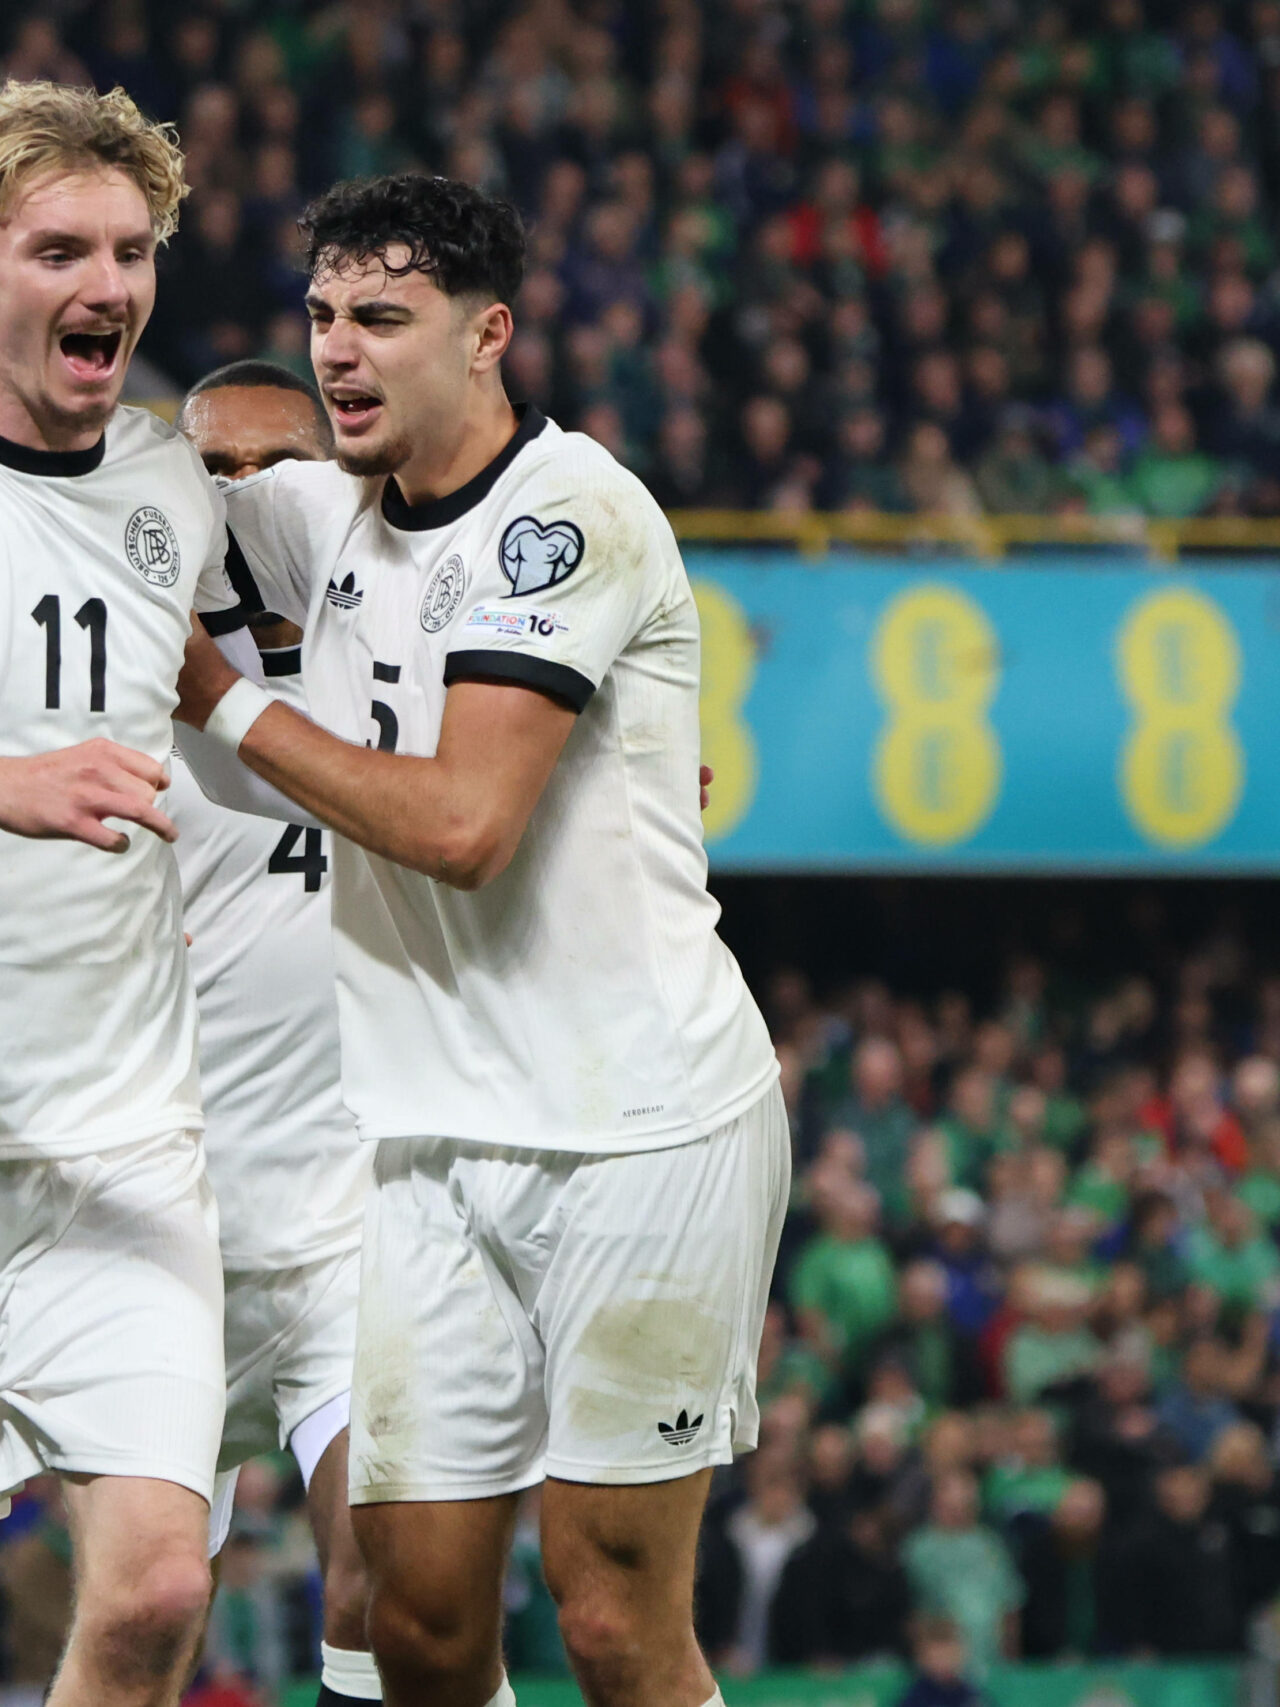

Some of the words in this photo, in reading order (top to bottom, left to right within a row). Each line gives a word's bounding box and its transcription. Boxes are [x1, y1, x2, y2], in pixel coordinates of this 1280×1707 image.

[31, 594, 107, 712] 11
[529, 614, 554, 636] 10
[365, 661, 401, 753] 5
[268, 823, 327, 892] 4
